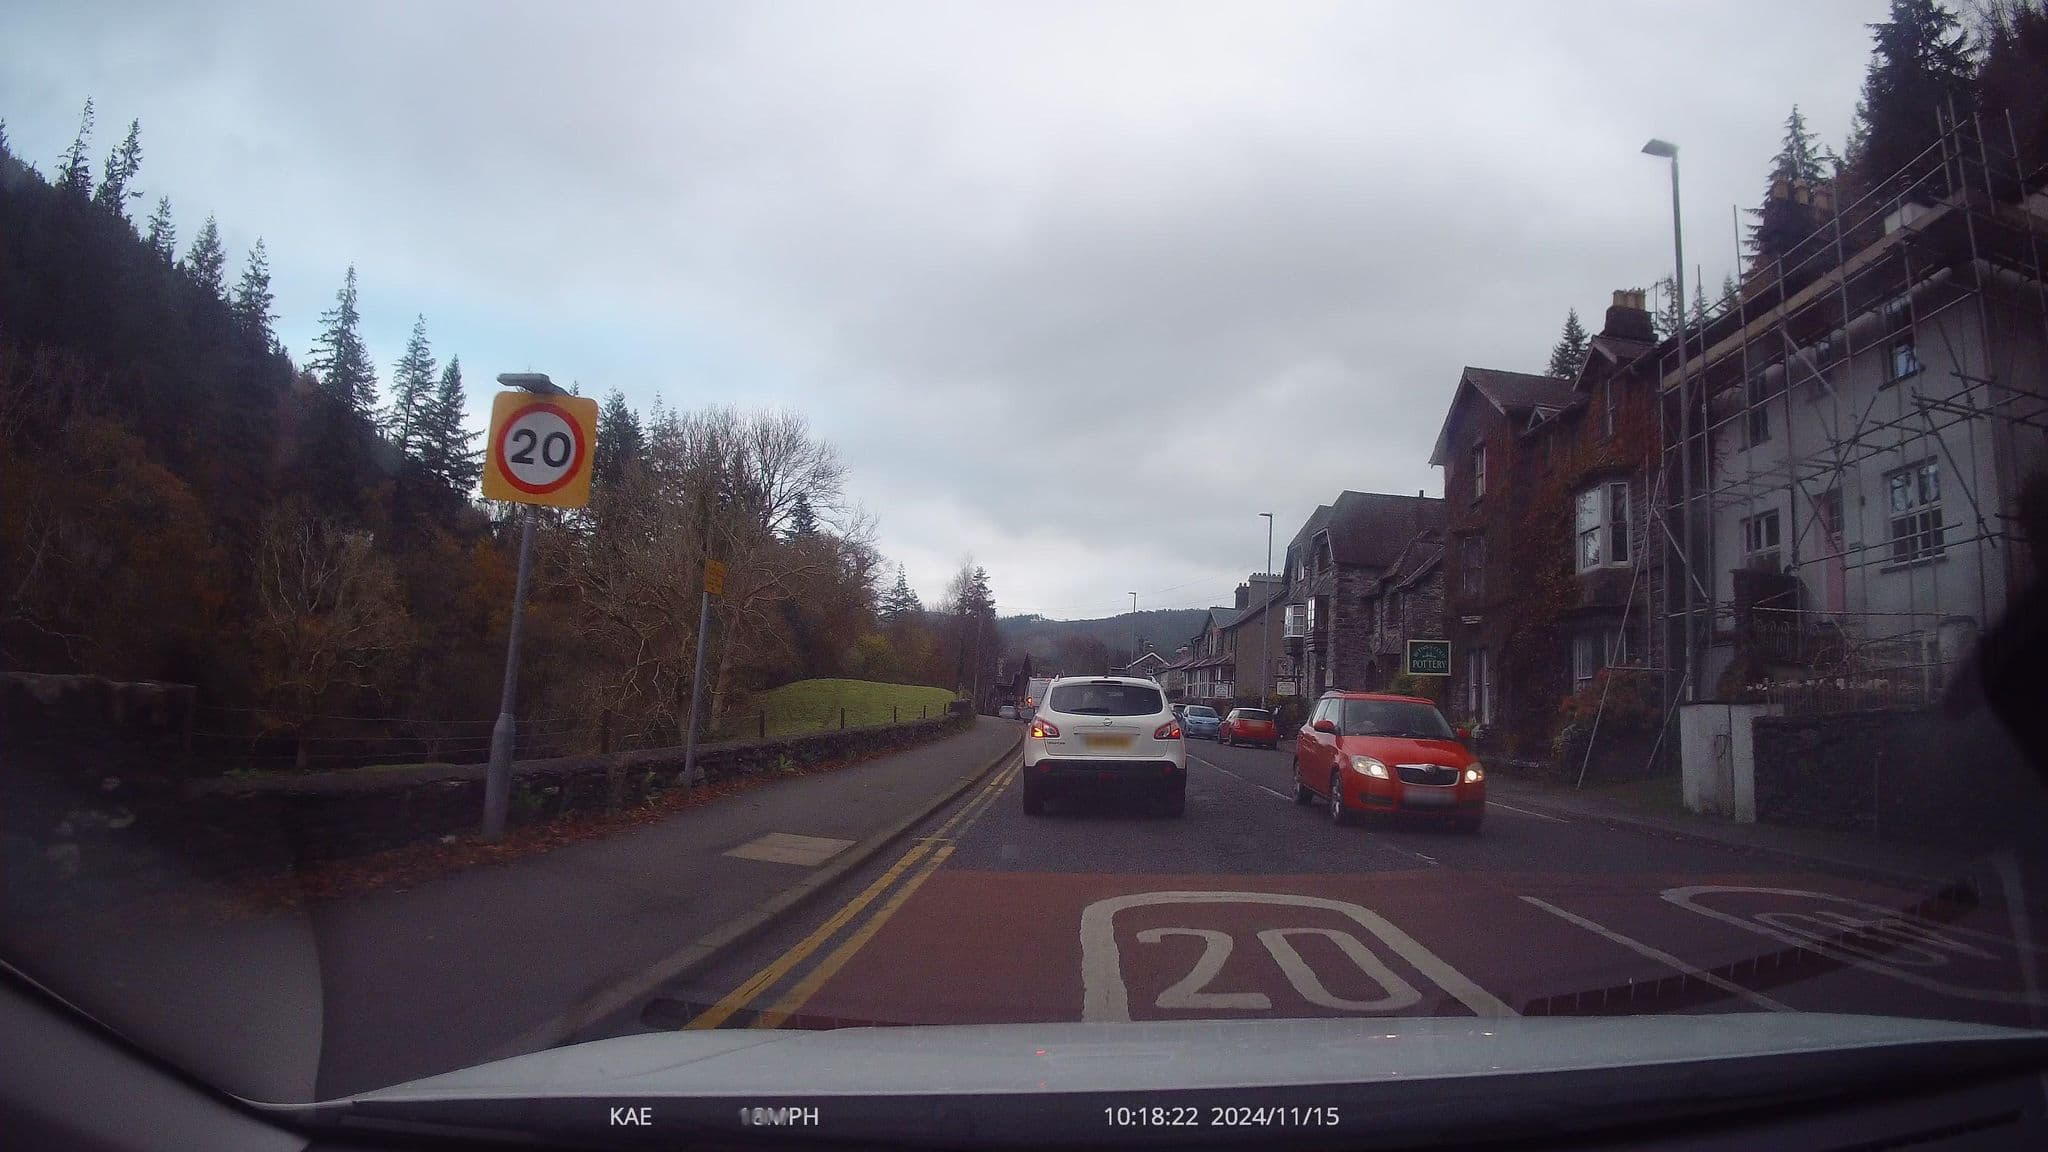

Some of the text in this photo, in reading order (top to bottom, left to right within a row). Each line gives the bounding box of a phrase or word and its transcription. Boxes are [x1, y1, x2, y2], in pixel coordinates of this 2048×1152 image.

[511, 428, 571, 468] 20
[1413, 659, 1448, 669] POTTERY
[1136, 927, 1423, 1011] 20
